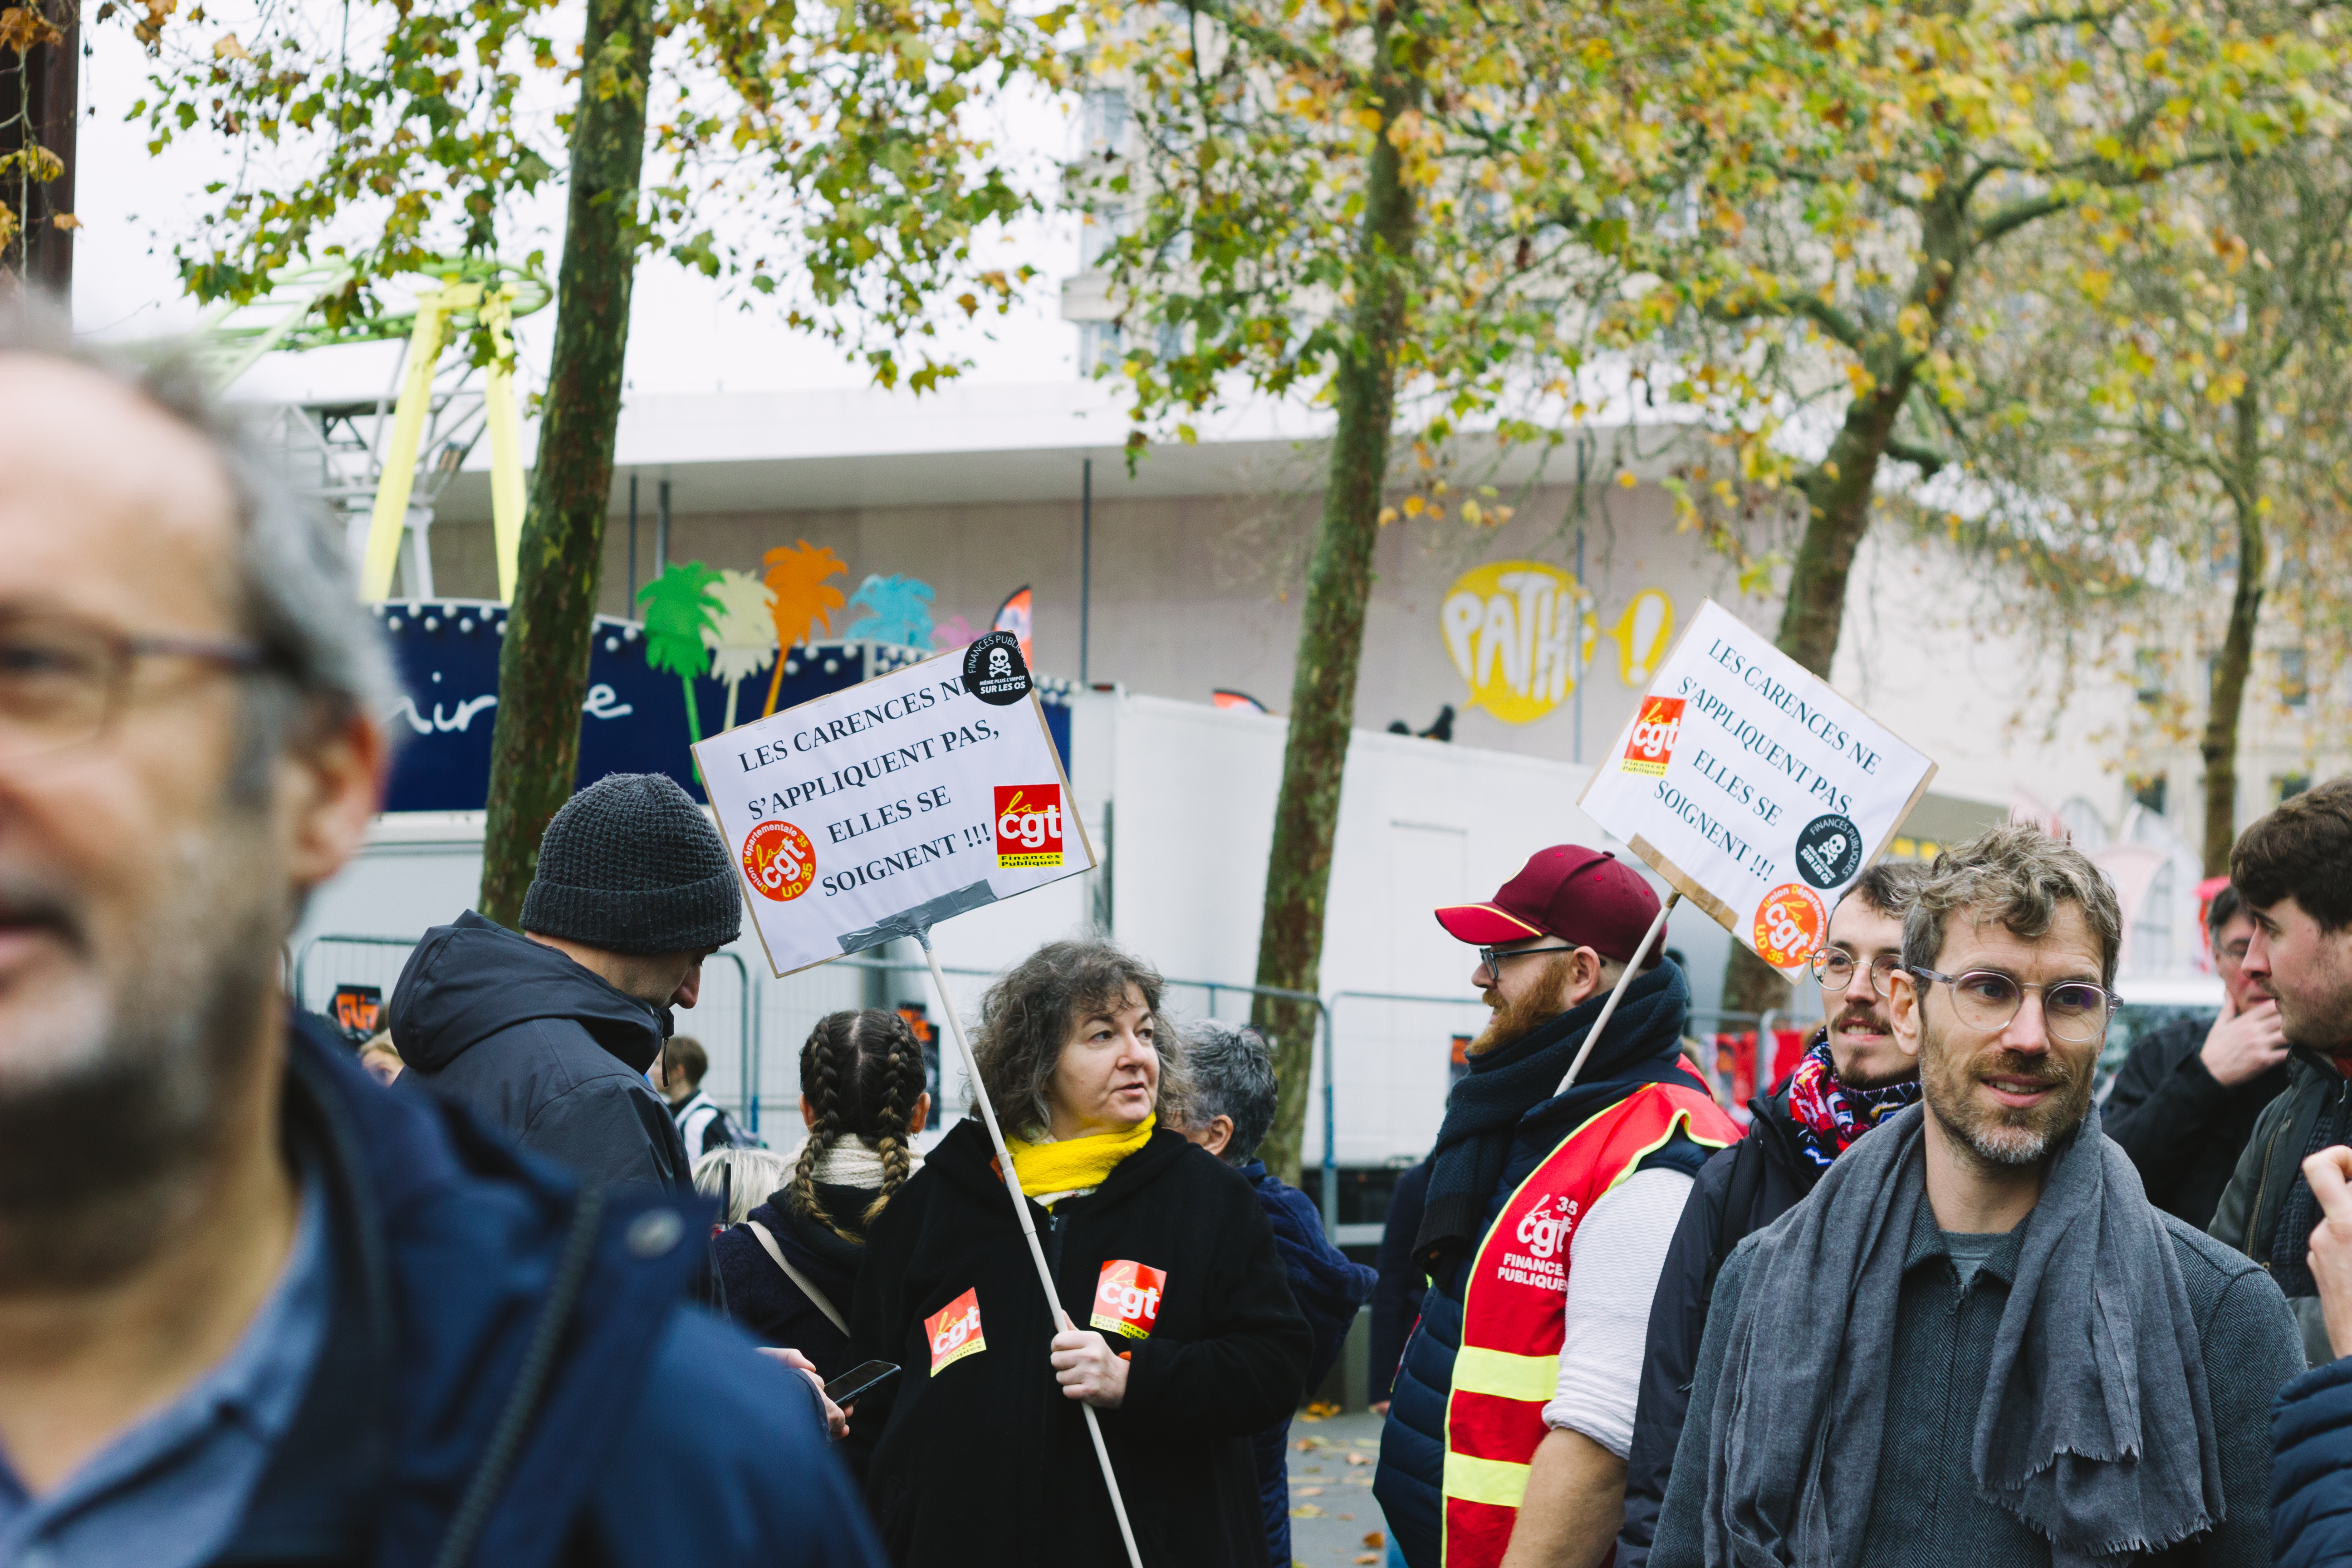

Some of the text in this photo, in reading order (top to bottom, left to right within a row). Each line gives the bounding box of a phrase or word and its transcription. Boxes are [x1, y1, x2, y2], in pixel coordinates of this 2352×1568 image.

[968, 635, 1027, 673] FINANCES PUBLIQ
[980, 681, 1026, 694] SUR LES OS
[1708, 638, 1882, 775] LES CARENCES NE
[738, 740, 788, 773] LES
[793, 688, 935, 752] CARENCES
[1640, 701, 1679, 725] la
[1677, 676, 1811, 786] S'APPLIQUENT
[1632, 717, 1679, 757] cgt
[749, 720, 1000, 820] S'APPLIQUENT PAS,
[1623, 766, 1664, 775] Publiques
[1625, 760, 1666, 769] Finances
[1000, 790, 1059, 816] la
[1692, 748, 1782, 827] ELLES SE
[826, 785, 951, 844] ELLES SE
[998, 804, 1062, 848] cgt
[1654, 779, 1775, 882] SOIGNENT !!!
[744, 823, 809, 893] Union Départementale 35
[756, 836, 789, 873] la
[762, 838, 806, 888] cgt
[822, 823, 991, 897] SOIGNENT !!!
[1800, 848, 1832, 885] SUR LES OS
[1810, 818, 1859, 877] FINANCES PUBLIQUES
[782, 863, 813, 898] UD 35
[1763, 887, 1789, 908] Union
[1792, 885, 1824, 951] Départementale
[1765, 903, 1810, 958] cgt
[1781, 901, 1811, 941] la
[1756, 924, 1784, 964] UD 35
[1525, 1194, 1573, 1224] la
[1556, 1196, 1578, 1215] 35
[1517, 1215, 1572, 1258] cgt
[1104, 1266, 1159, 1295] la
[1503, 1253, 1565, 1277] FINANCE
[1099, 1282, 1160, 1319] cgt
[933, 1306, 980, 1355] cgt
[1095, 1321, 1143, 1339] Publique
[1096, 1316, 1146, 1337] Finances
